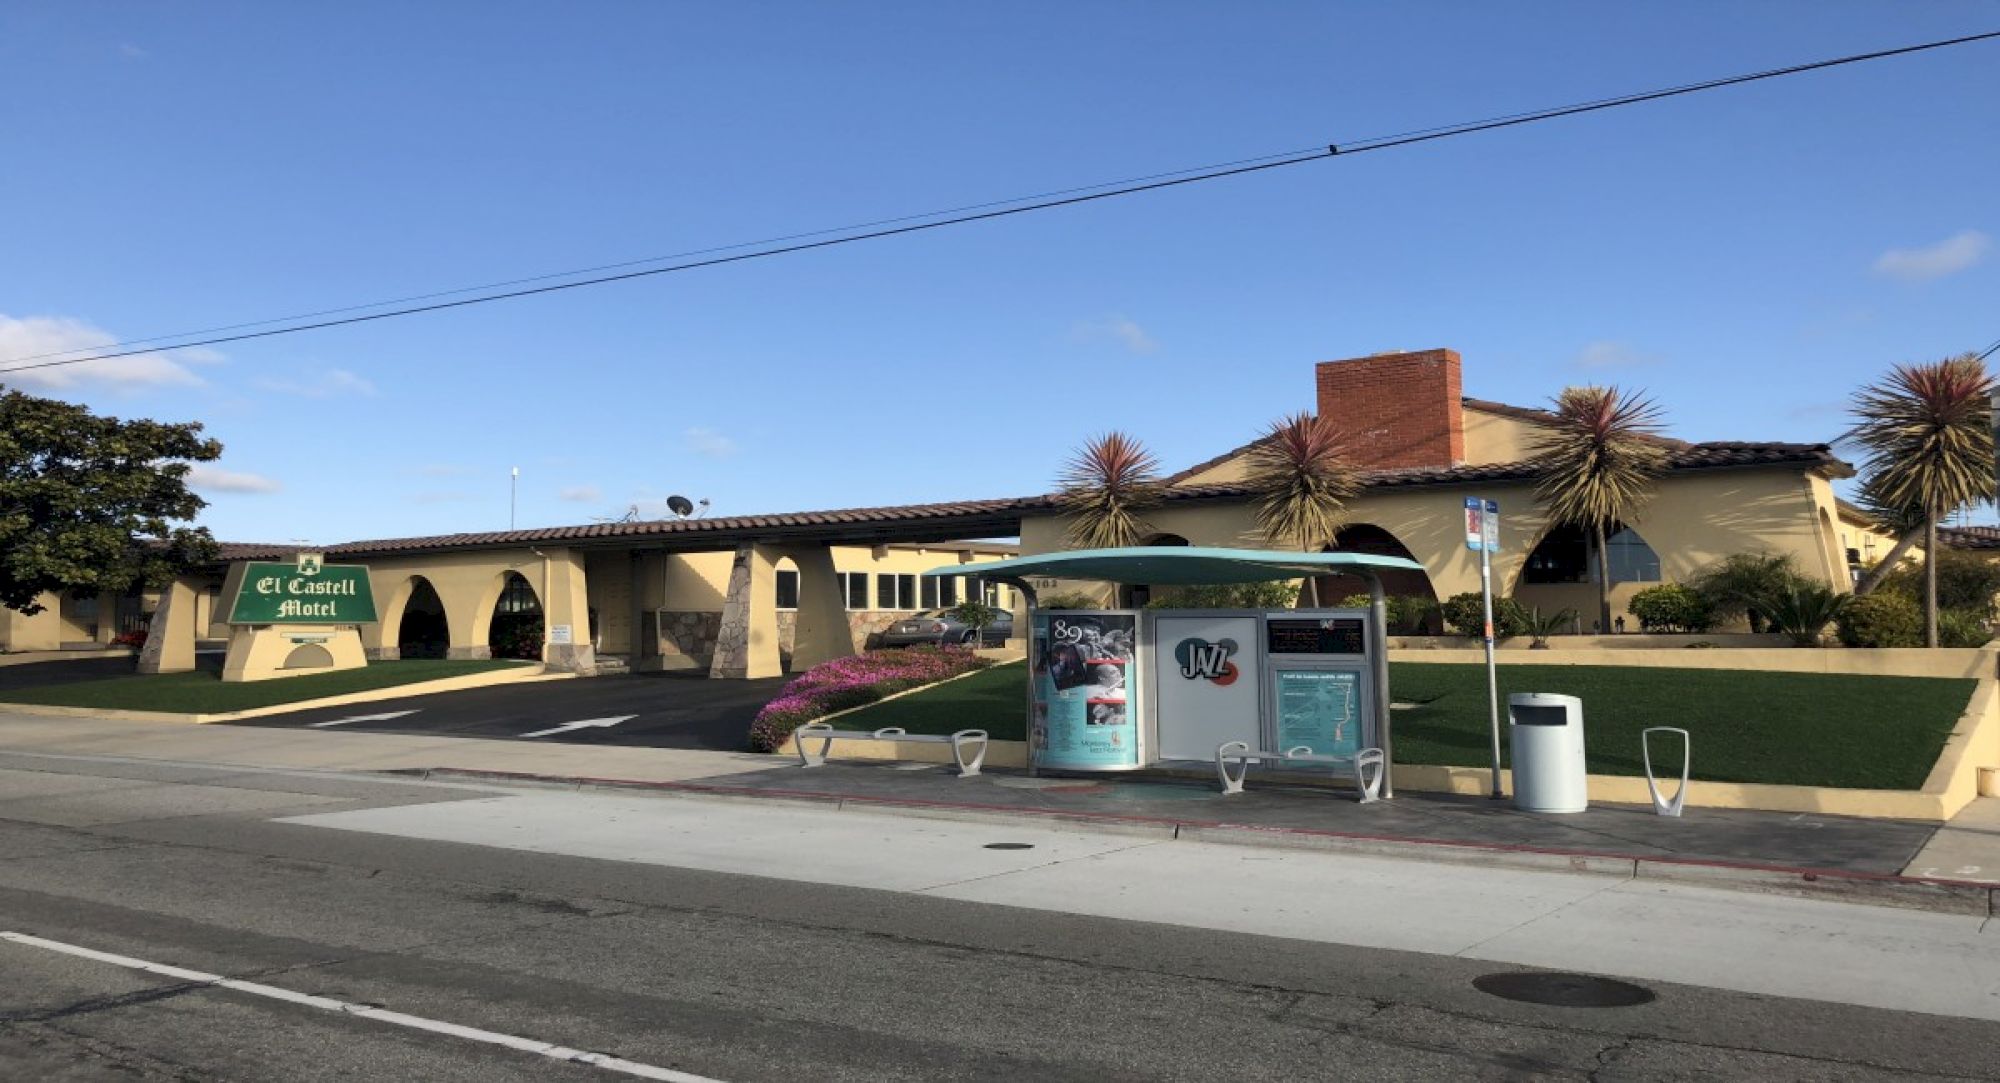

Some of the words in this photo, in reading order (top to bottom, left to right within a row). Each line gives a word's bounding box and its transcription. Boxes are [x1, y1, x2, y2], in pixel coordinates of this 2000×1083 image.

[256, 577, 281, 594] El
[287, 577, 356, 596] Castell
[276, 599, 337, 618] Motel
[1054, 619, 1083, 643] 89
[1182, 643, 1231, 679] JAZZ
